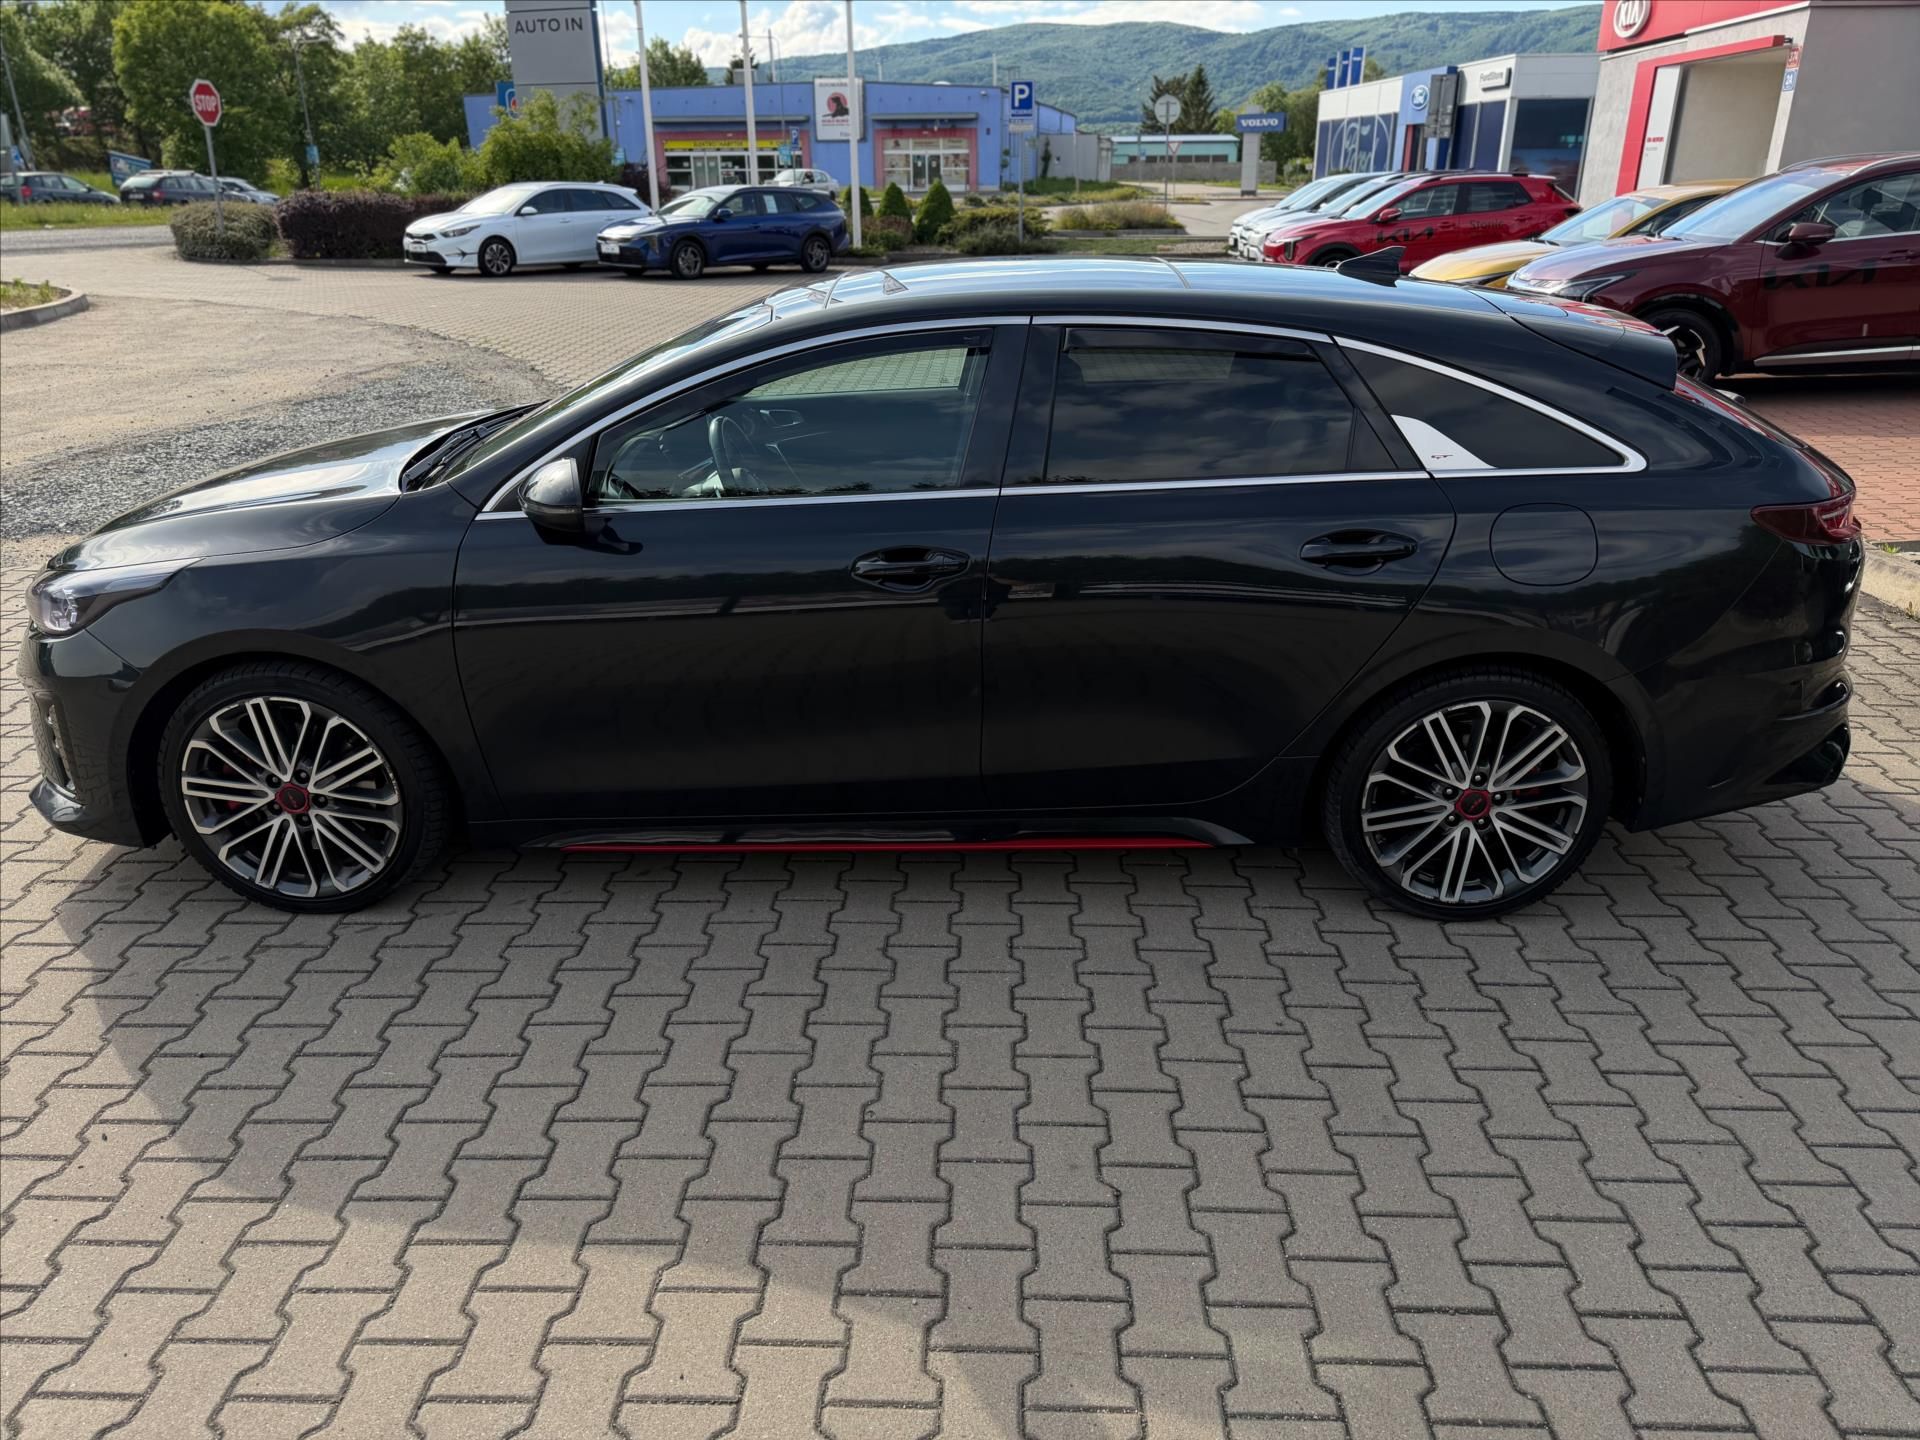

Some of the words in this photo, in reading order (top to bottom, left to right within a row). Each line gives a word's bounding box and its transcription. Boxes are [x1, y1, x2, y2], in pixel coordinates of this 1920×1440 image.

[1618, 1, 1641, 27] KIA
[514, 18, 561, 34] AUTO
[565, 17, 583, 31] IN
[195, 94, 217, 112] STOP
[1014, 84, 1029, 107] P
[1240, 118, 1279, 127] VOLVO
[1377, 226, 1434, 242] KIA
[1764, 257, 1877, 290] KIA
